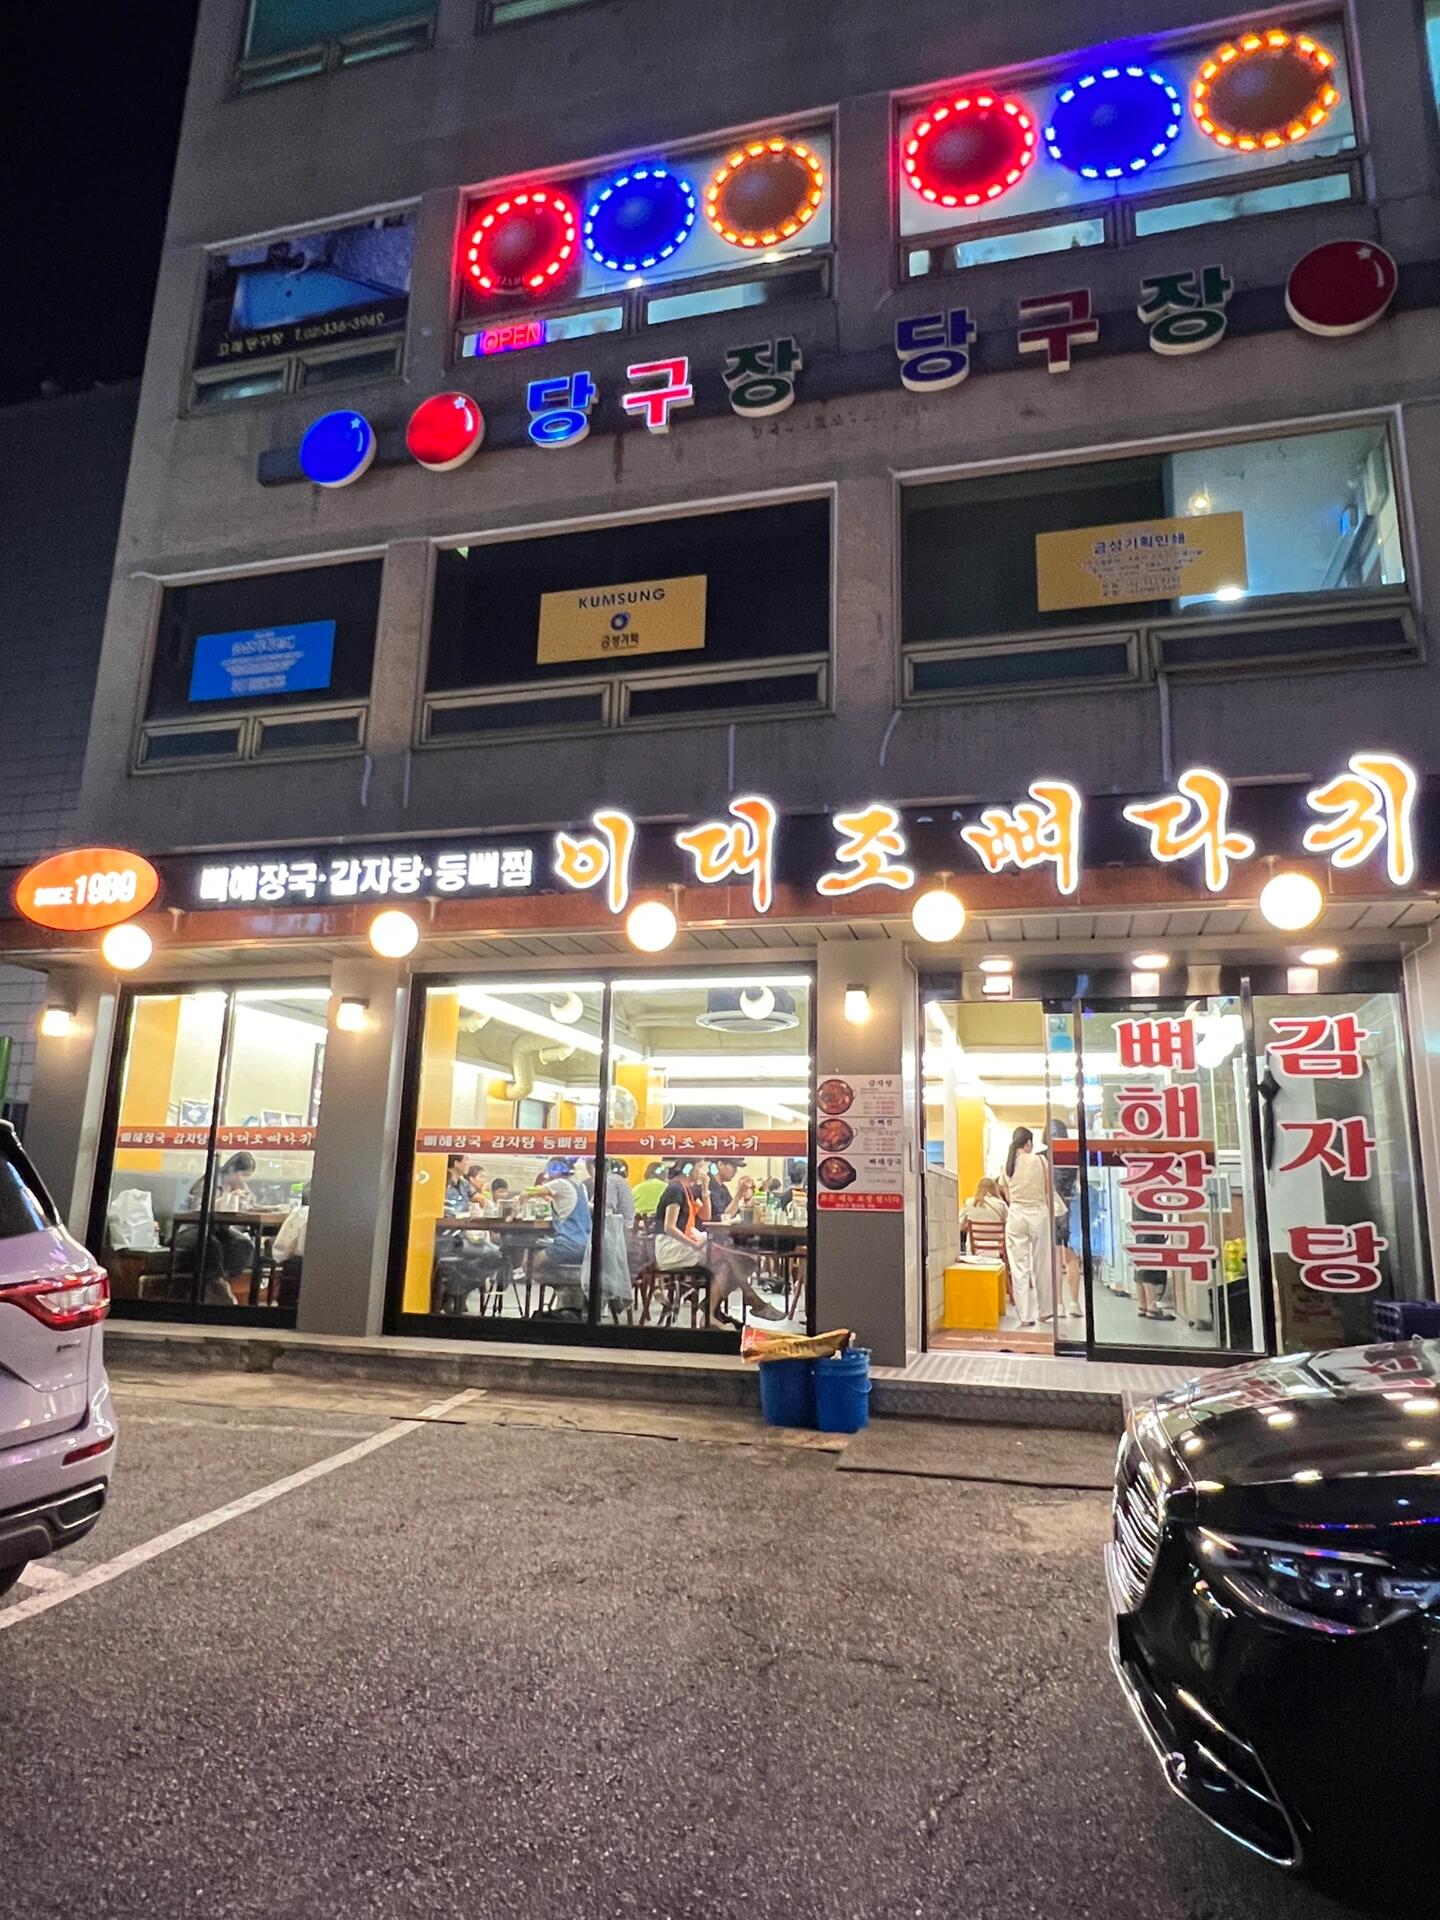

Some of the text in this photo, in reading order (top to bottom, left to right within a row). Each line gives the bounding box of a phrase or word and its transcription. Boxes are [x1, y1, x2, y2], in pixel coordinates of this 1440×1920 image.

[484, 323, 542, 352] OPEN
[526, 264, 1233, 449] 당구장 당구장
[1093, 532, 1186, 555] 금성기획인쇄
[578, 588, 666, 609] KUMSUNG
[601, 633, 640, 649] 금성기획
[423, 1135, 588, 1149] 뼈해장국 감자탕 등뼈찜
[1112, 1017, 1219, 1286] 뼈해장국
[1266, 1012, 1388, 1293] 감자탕
